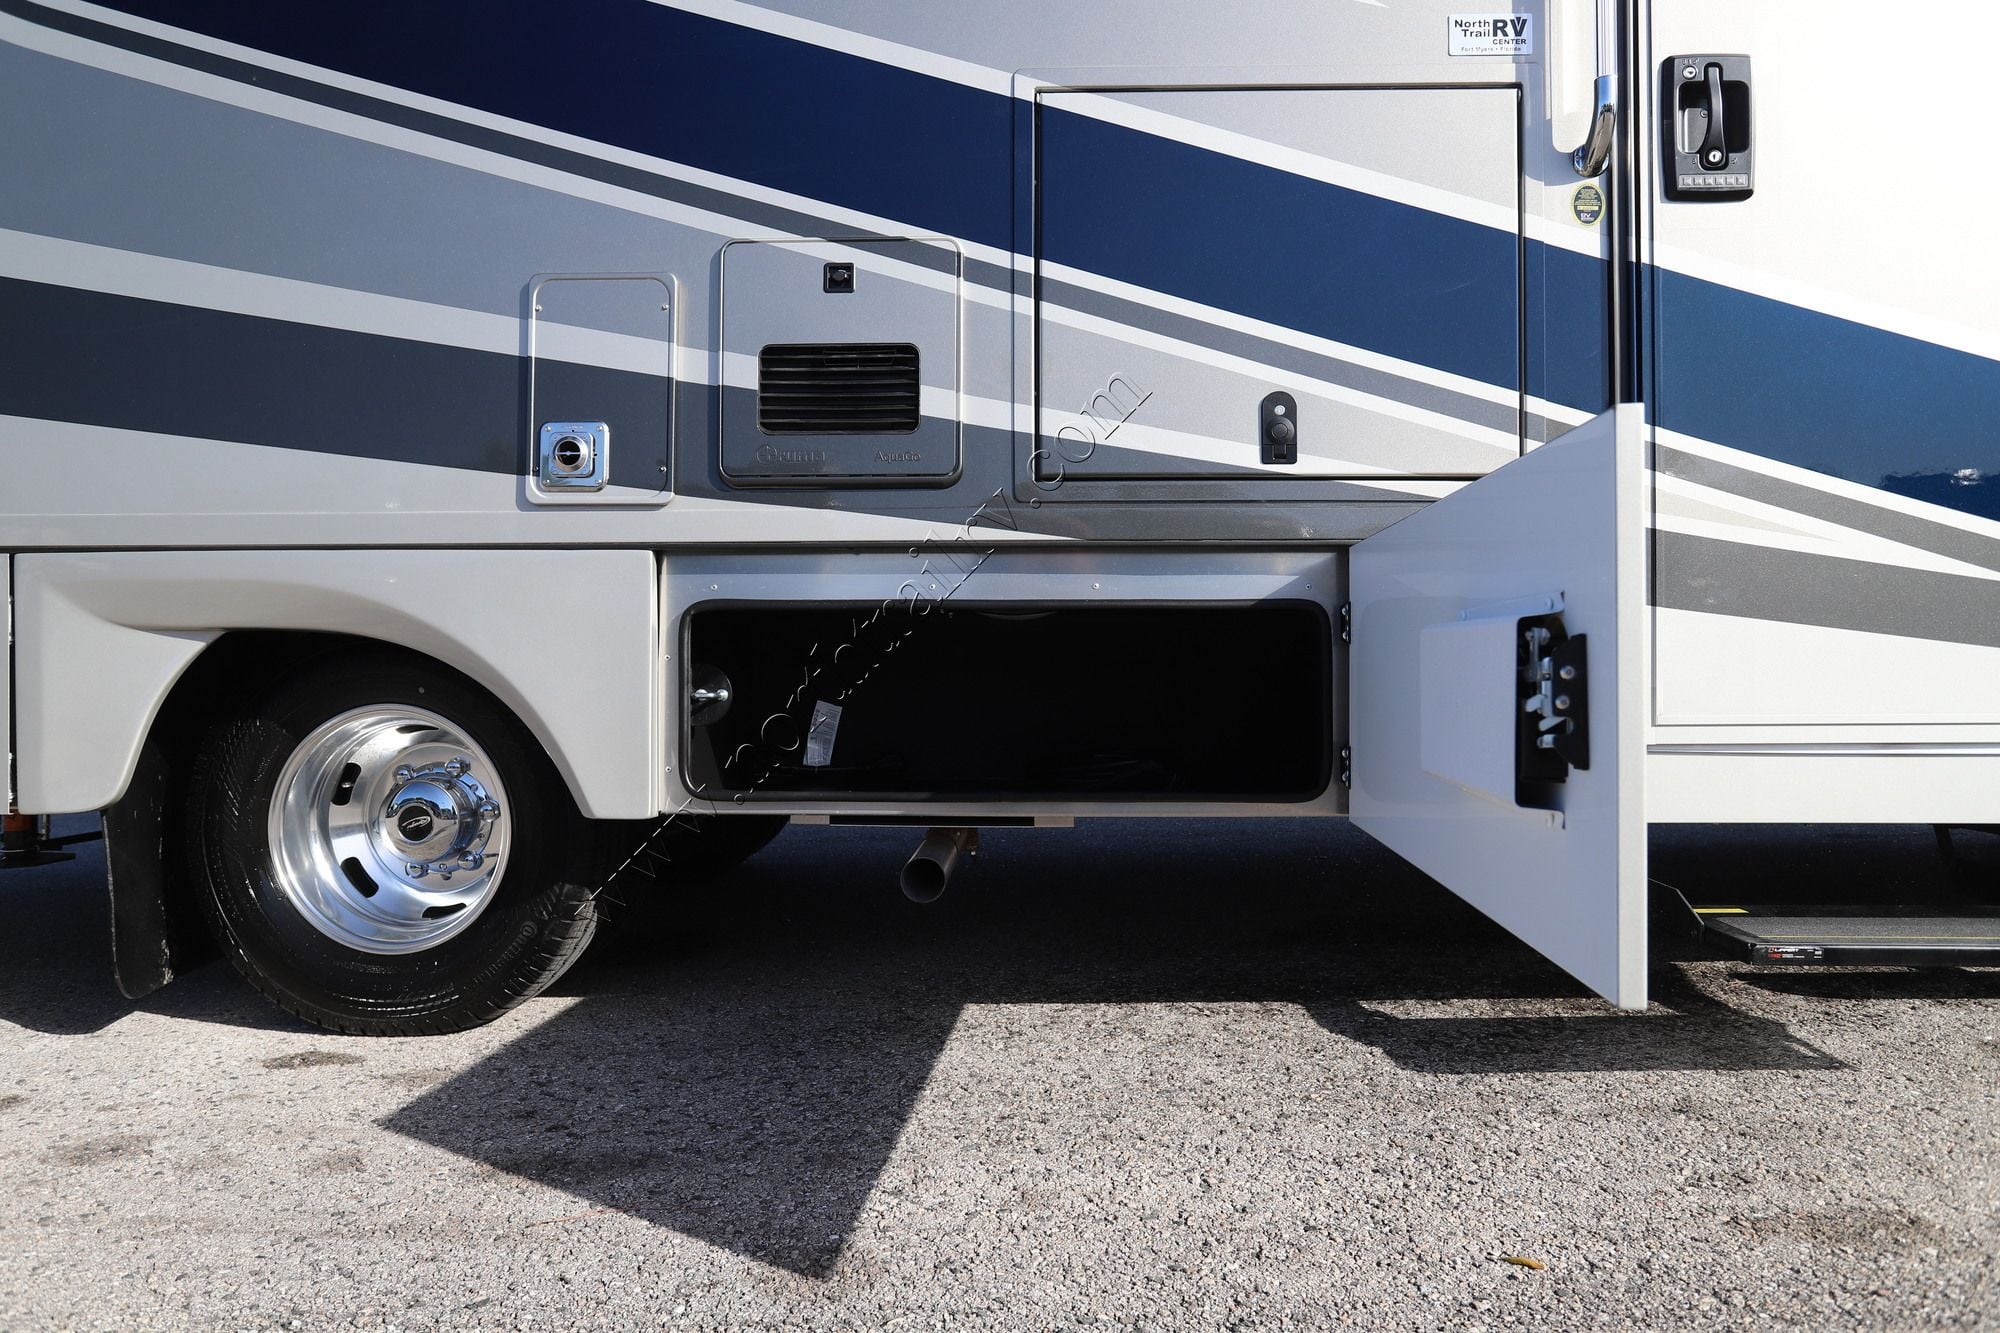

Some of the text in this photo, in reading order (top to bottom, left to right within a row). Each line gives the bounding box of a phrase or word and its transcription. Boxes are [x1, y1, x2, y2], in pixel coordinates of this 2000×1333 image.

[1454, 19, 1490, 28] North
[1492, 16, 1528, 37] RV
[1461, 29, 1490, 37] Trail
[875, 450, 922, 463] AquaGo
